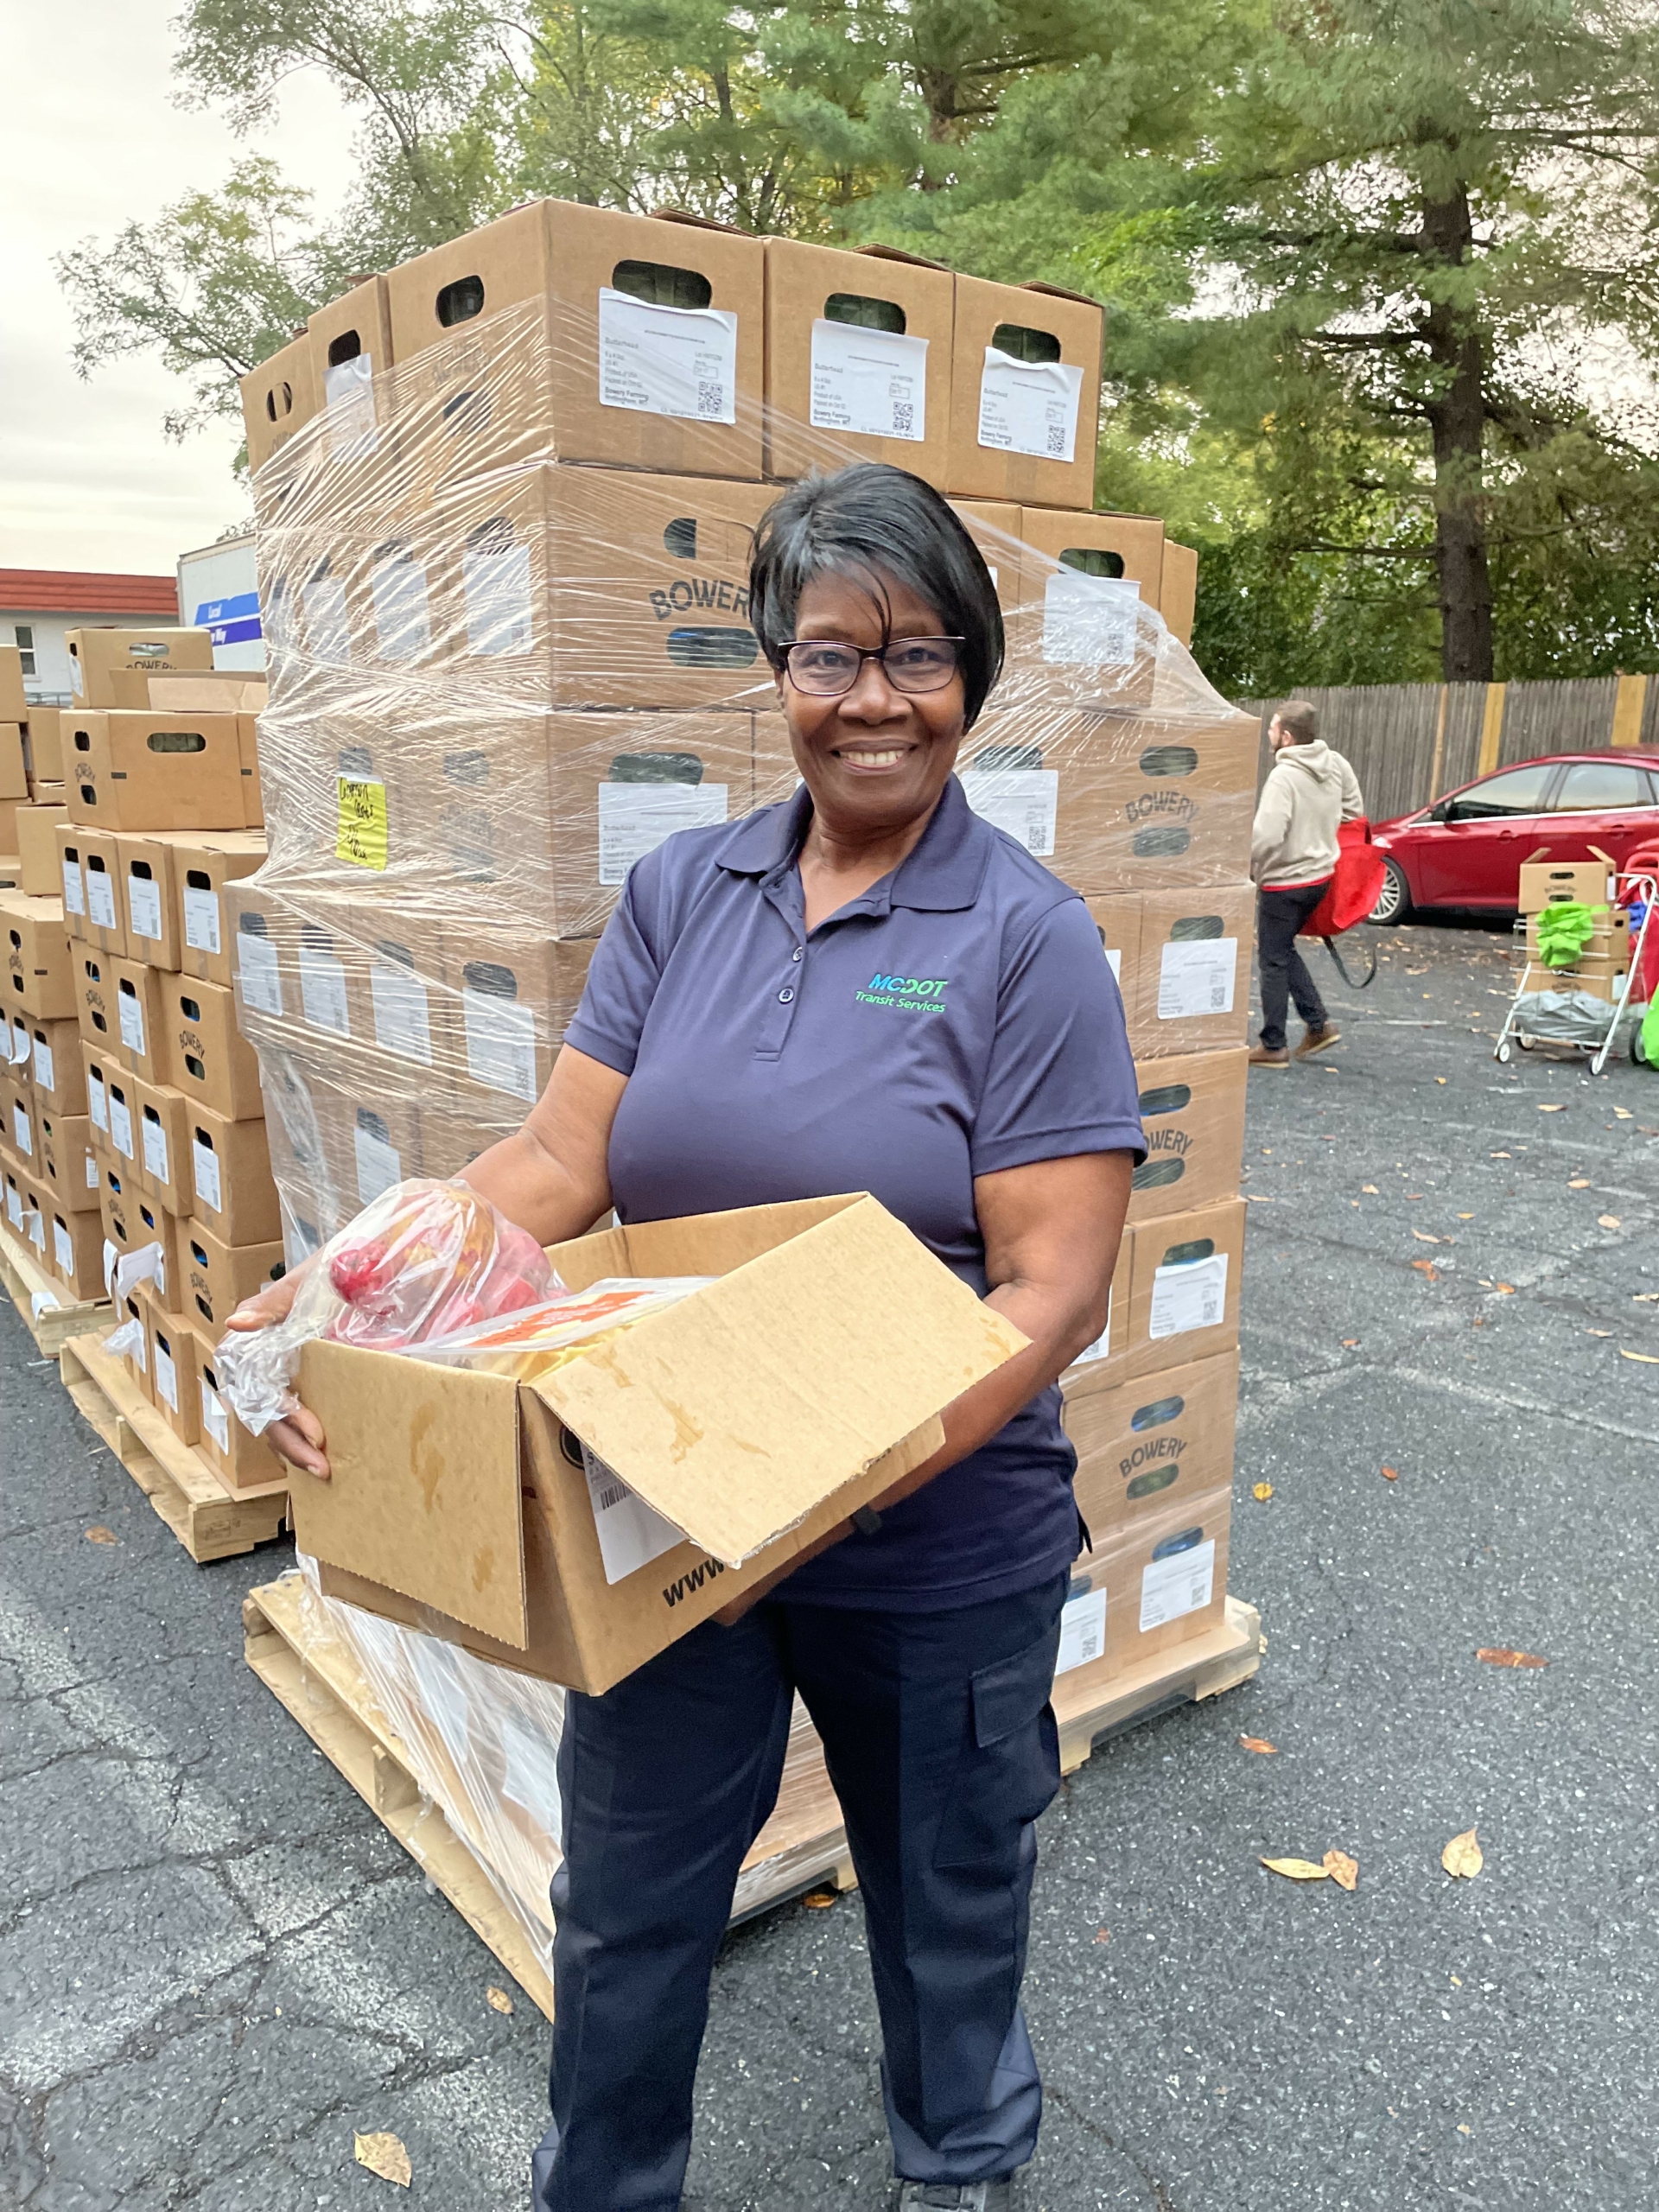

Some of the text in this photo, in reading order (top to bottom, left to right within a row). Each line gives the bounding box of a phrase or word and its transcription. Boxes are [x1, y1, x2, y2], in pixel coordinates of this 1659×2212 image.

[605, 386, 649, 401] Bowery Farming
[813, 409, 851, 422] Bowery Farming
[1125, 791, 1199, 824] BOWERY
[868, 973, 949, 997] MCDOT
[855, 990, 946, 1013] Transit Services
[179, 1029, 205, 1059] BOWERY
[188, 1271, 213, 1305] BOWERY
[1119, 1437, 1188, 1478] BOWERY
